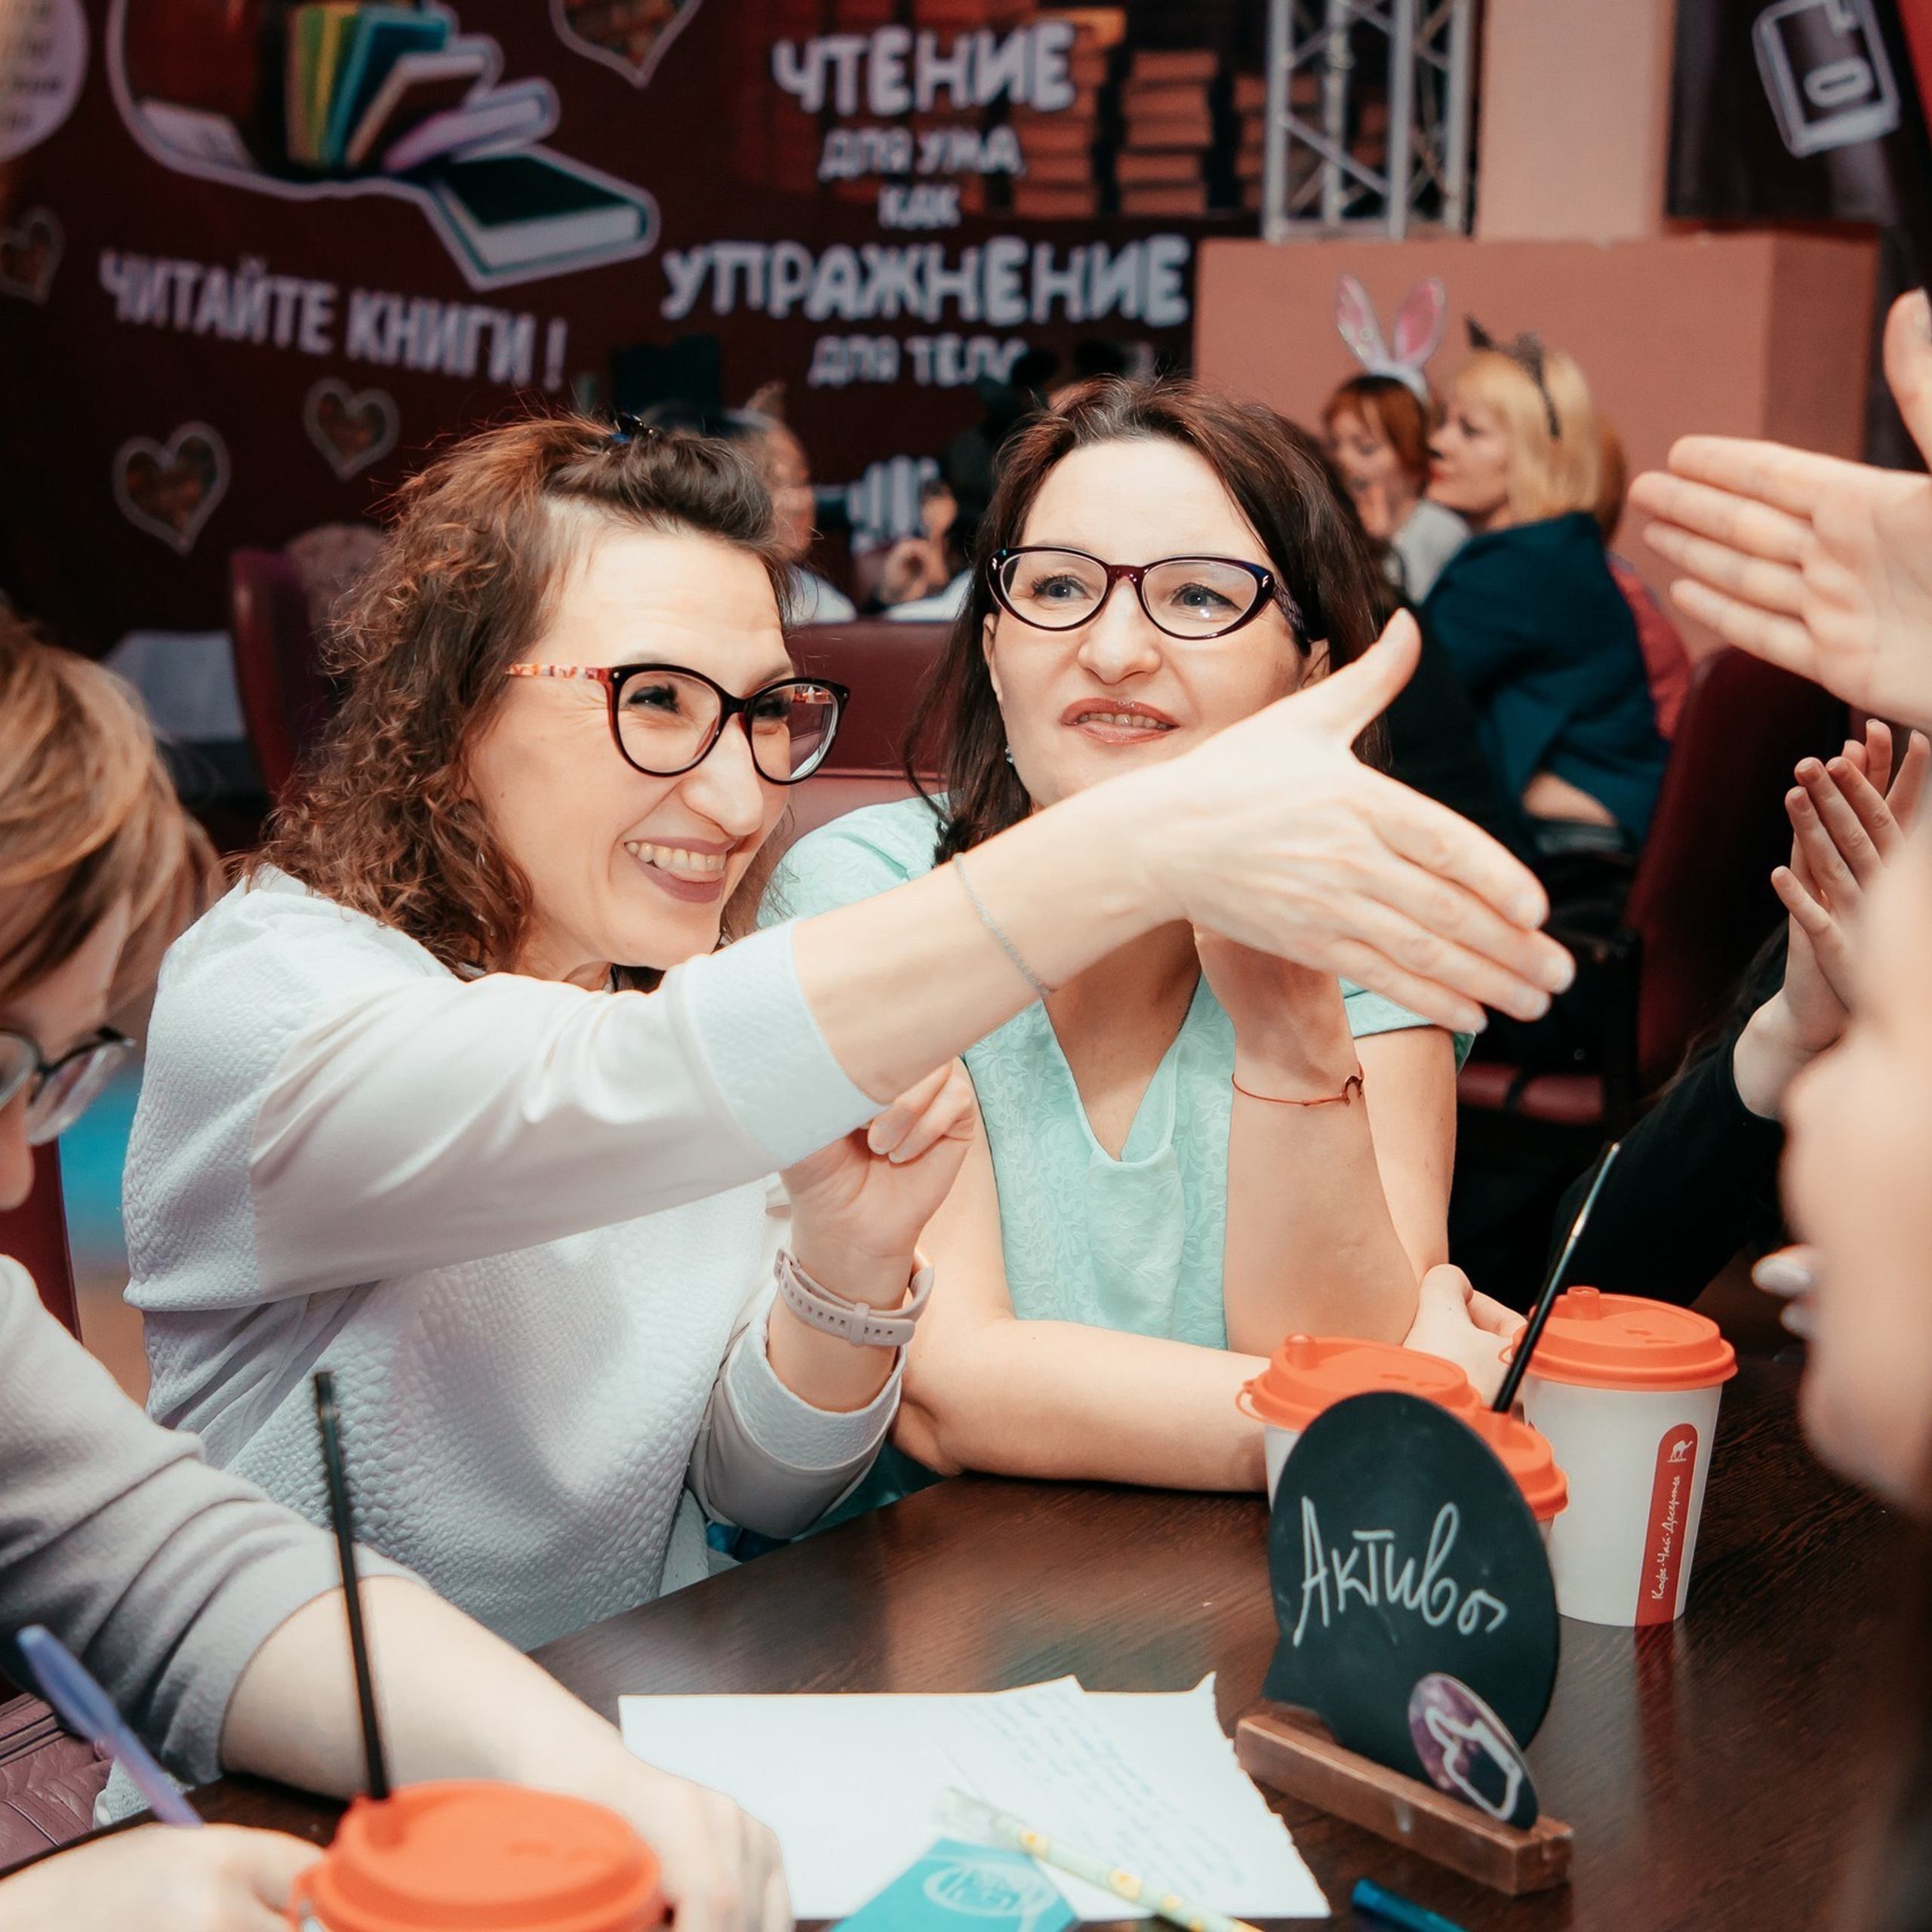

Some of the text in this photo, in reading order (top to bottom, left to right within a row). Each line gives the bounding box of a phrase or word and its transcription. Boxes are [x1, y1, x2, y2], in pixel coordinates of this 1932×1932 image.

[773, 21, 1075, 114] ЧТЕНИЕ
[915, 125, 1028, 178] УМА
[877, 183, 961, 229] КАК
[99, 248, 337, 356] ЧИТАЙТЕ
[345, 287, 536, 388] КНИГИ
[661, 234, 1190, 327] УПРАЖНЕНИЕ
